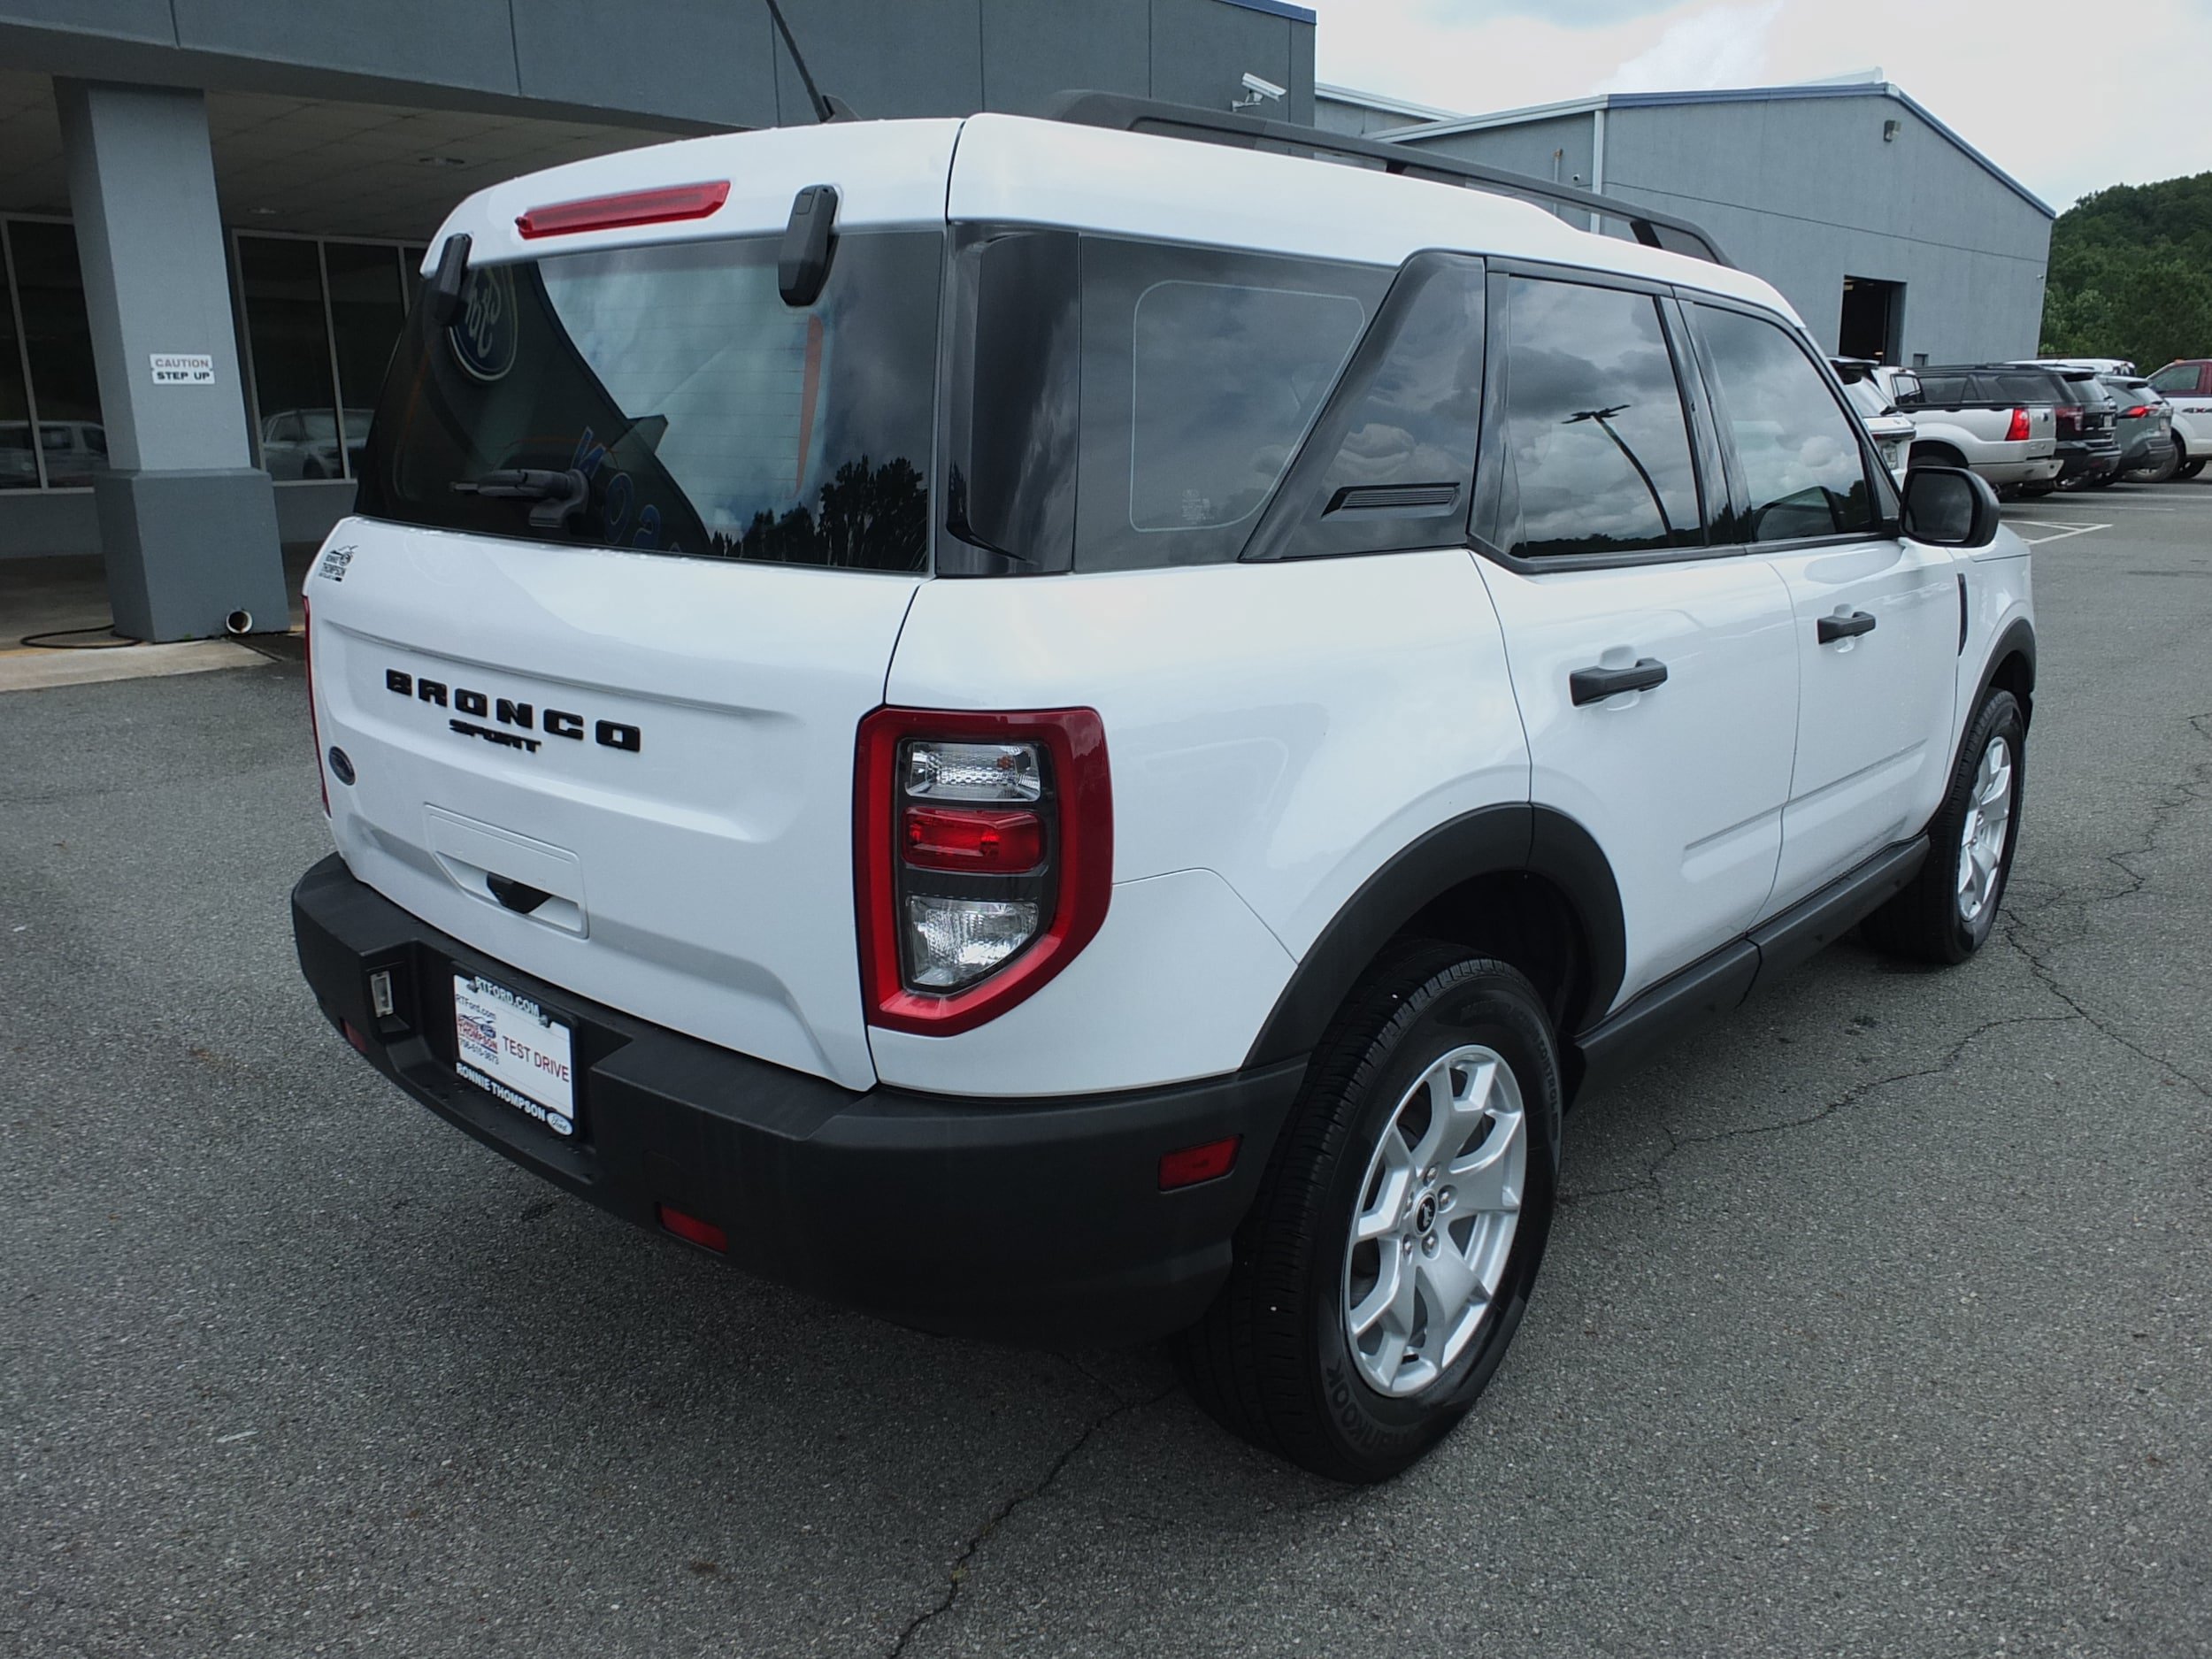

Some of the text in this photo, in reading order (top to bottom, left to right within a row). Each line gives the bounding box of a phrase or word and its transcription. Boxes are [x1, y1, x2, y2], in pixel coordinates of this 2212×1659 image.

[155, 357, 209, 368] CAUTION
[157, 371, 211, 380] STEP UP
[386, 668, 641, 753] BRONCO
[449, 718, 542, 753] SPORT
[474, 976, 540, 1017] RTFORD.COM
[502, 1036, 570, 1083] TEST DRIVE
[456, 1062, 546, 1121] RONNIE THOMPSON
